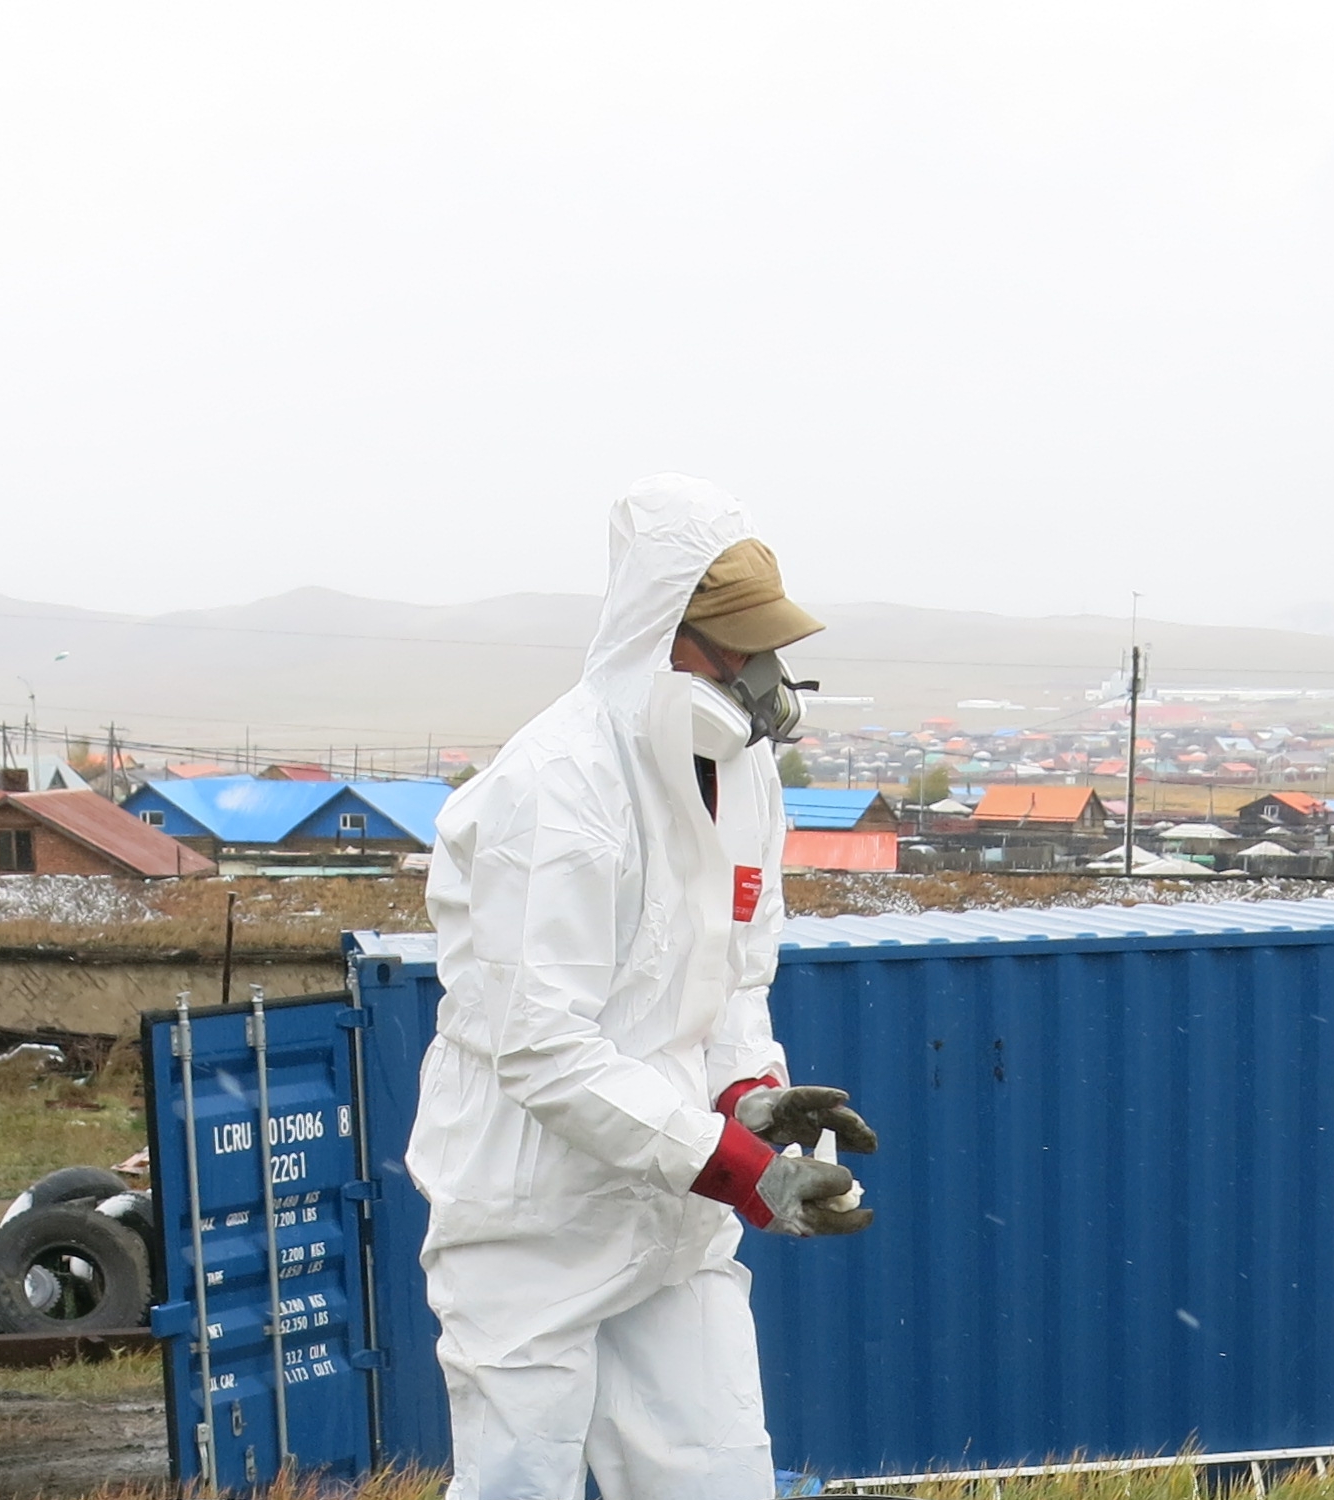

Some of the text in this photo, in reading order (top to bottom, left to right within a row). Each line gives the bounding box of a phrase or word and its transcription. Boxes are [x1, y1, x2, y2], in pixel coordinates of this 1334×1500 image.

[214, 1105, 351, 1154] LCRU 015086 8
[270, 1151, 306, 1183] 22G1
[302, 1207, 317, 1223] LBS
[310, 1242, 326, 1258] KGS
[206, 1270, 225, 1286] TARE
[307, 1260, 324, 1274] LBS
[308, 1293, 327, 1309] KGS
[206, 1322, 223, 1340] NET
[314, 1311, 329, 1327] LBS
